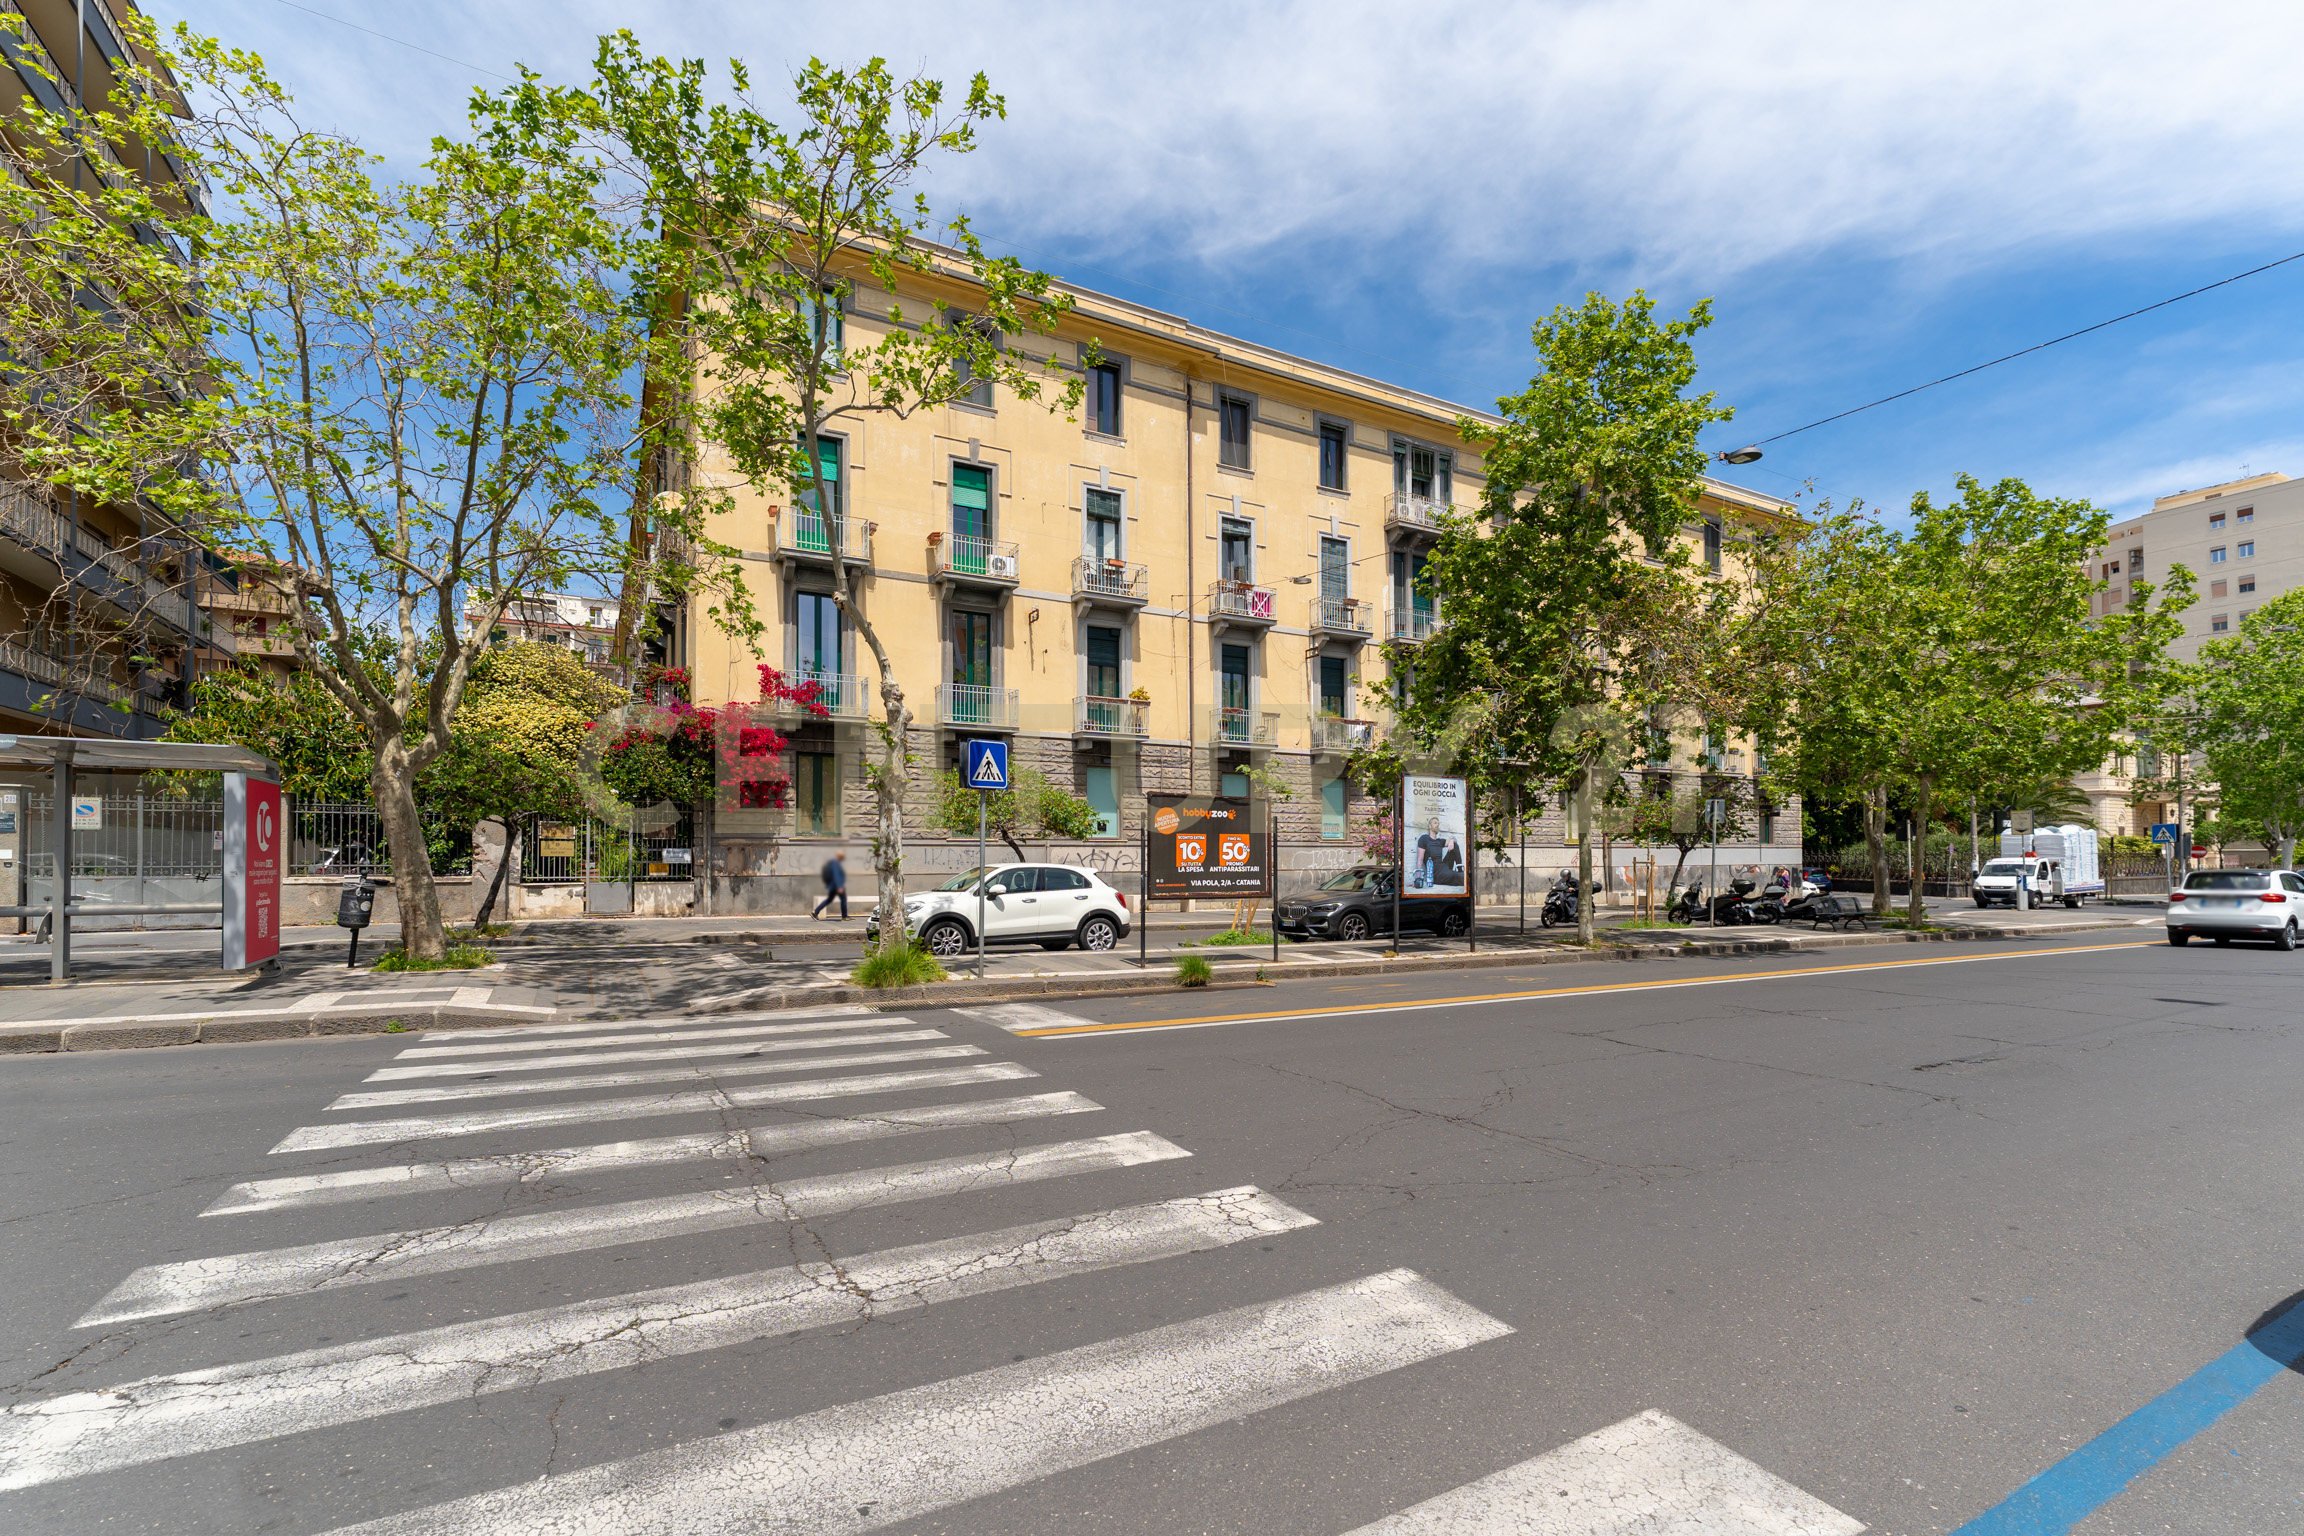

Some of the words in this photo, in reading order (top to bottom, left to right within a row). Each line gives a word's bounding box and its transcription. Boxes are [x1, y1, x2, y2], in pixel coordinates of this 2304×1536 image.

[1413, 780, 1448, 789] EQUILIBRIO
[1156, 813, 1175, 822] NUOVA
[1183, 808, 1228, 820] hobbyzoo
[1154, 817, 1180, 828] APERTURA
